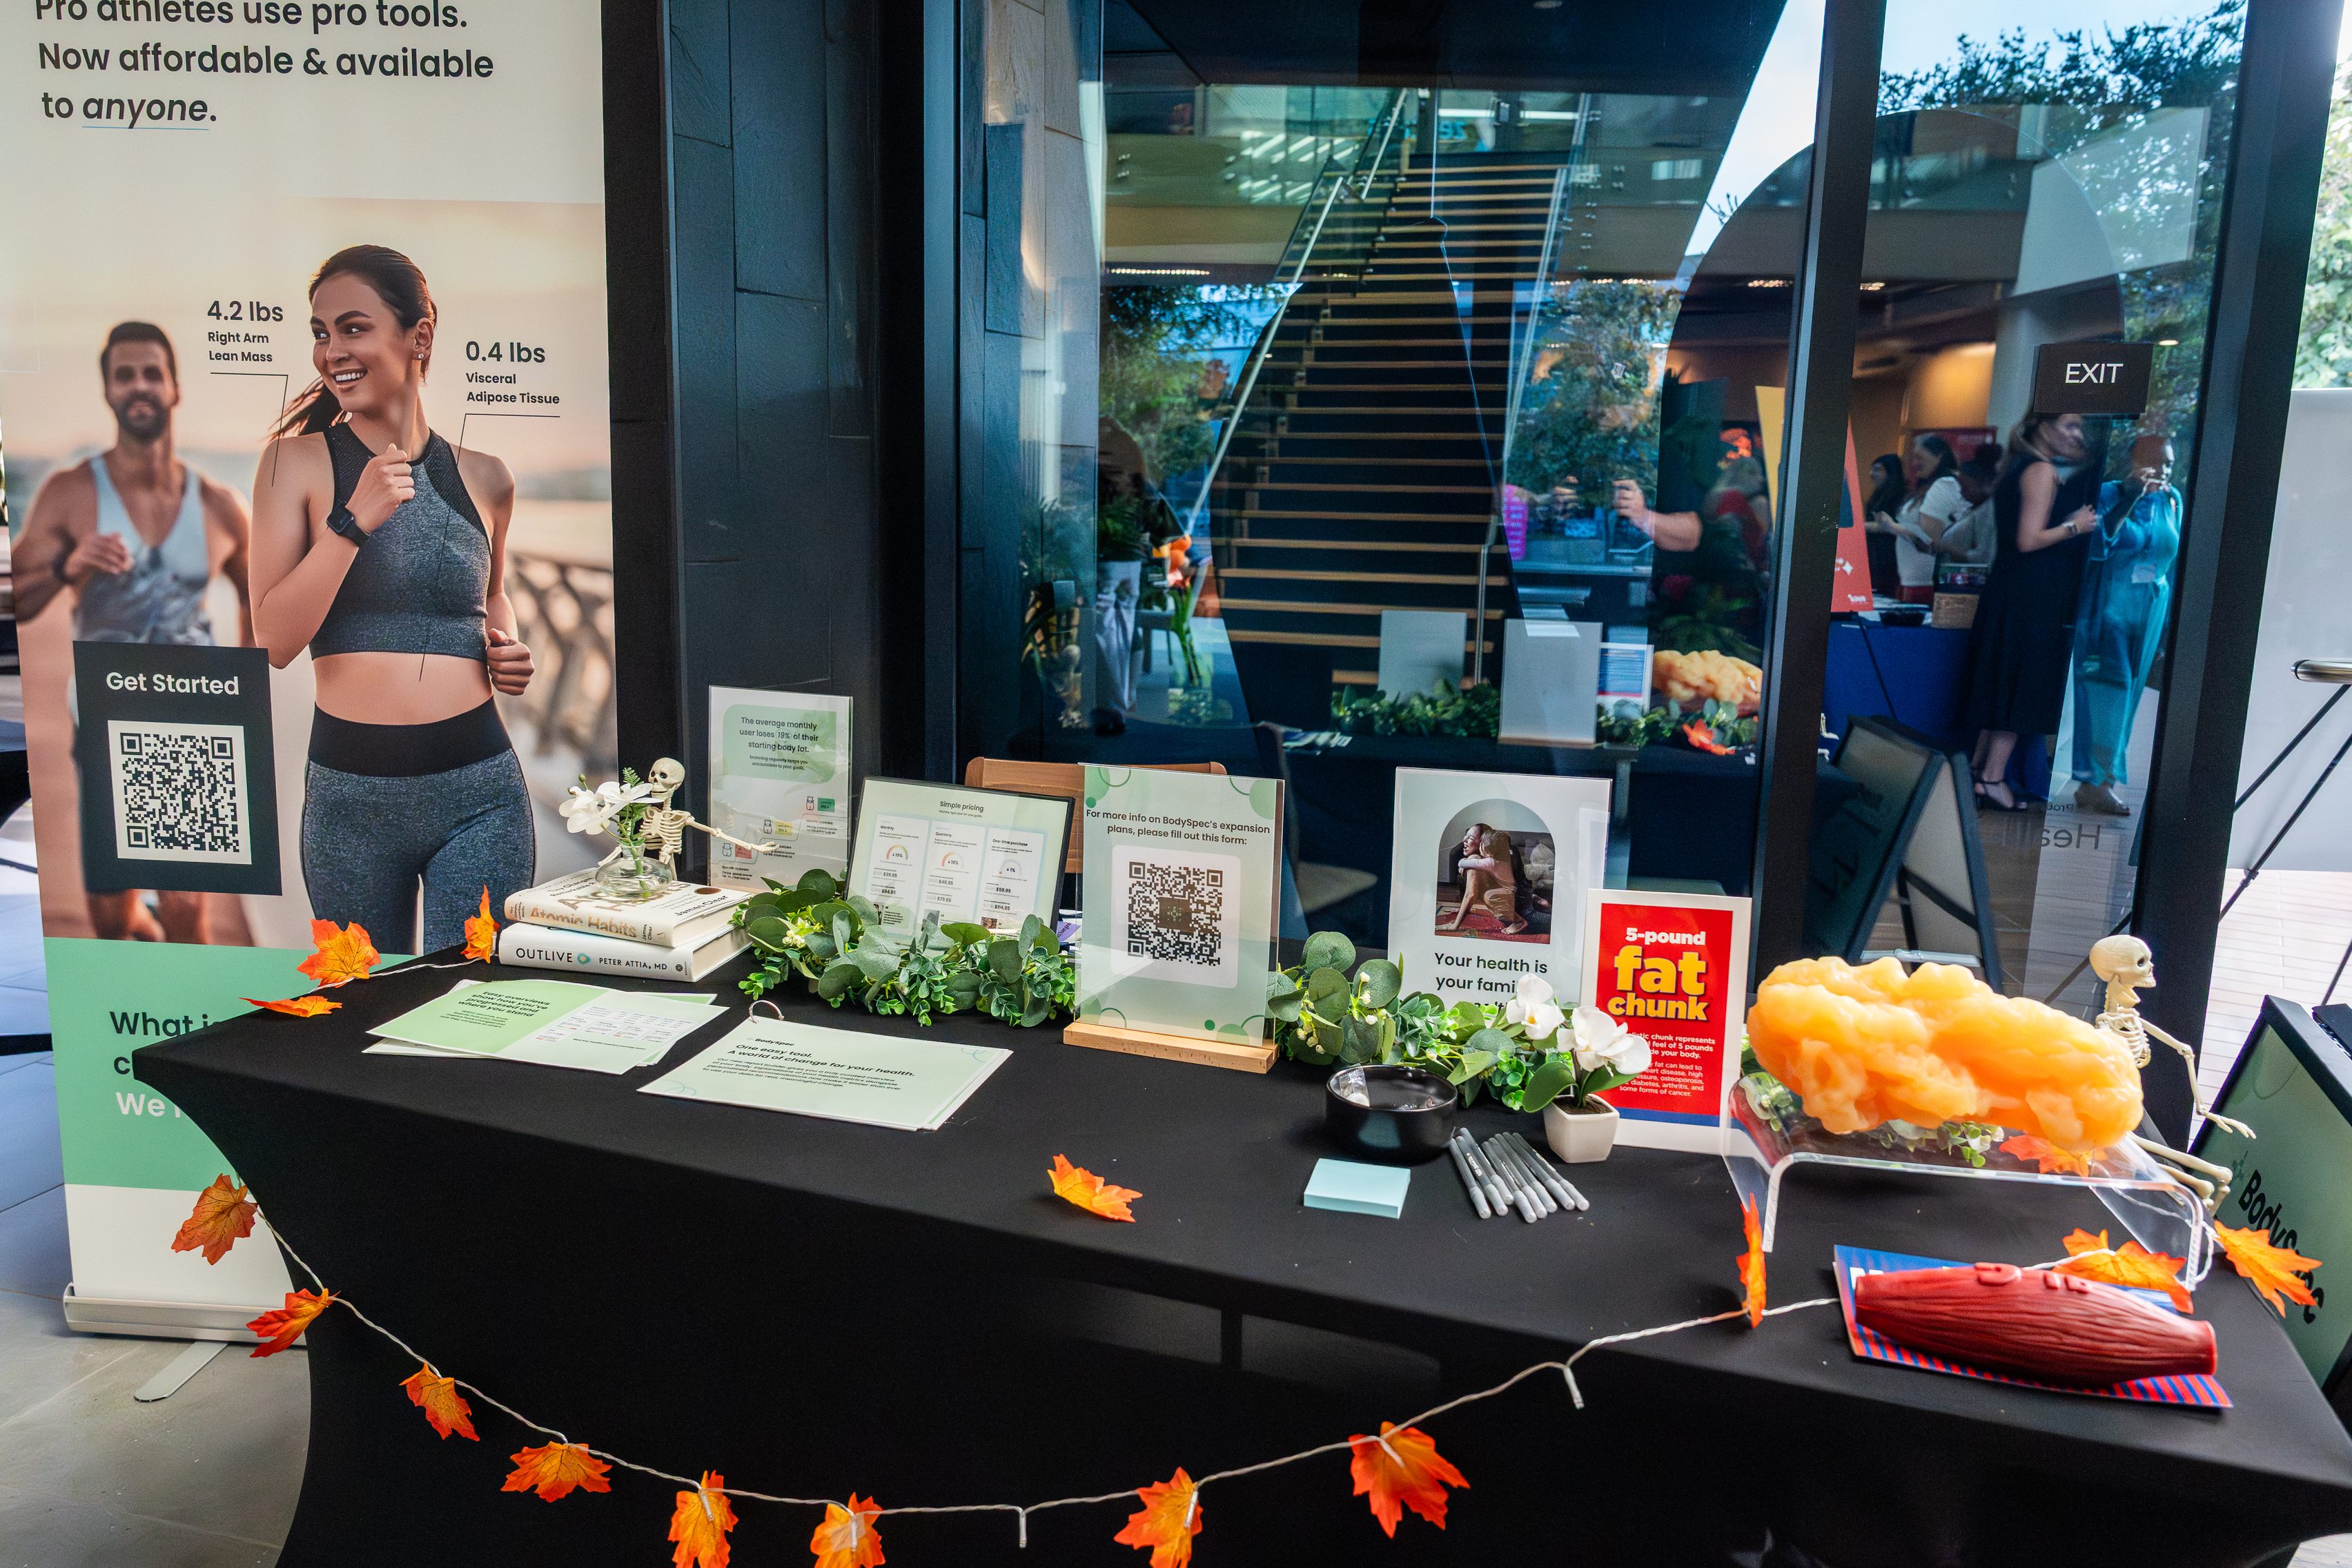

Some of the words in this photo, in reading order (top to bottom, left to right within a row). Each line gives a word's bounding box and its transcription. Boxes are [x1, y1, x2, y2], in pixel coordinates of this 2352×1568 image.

[37, 0, 88, 21] Pro
[97, 0, 233, 23] athletes
[244, 1, 302, 26] use
[313, 4, 367, 34] pro
[377, 0, 468, 28] tools.
[39, 43, 110, 71] Now
[119, 43, 293, 75] affordable
[303, 48, 329, 76] &
[336, 47, 494, 78] available
[41, 92, 74, 119] to
[83, 94, 217, 129] anyone.
[207, 300, 243, 322] 4.2
[248, 301, 284, 323] lbs
[208, 331, 239, 346] Right
[241, 332, 269, 344] Arm
[208, 350, 238, 362] Lean
[241, 351, 273, 364] Mass
[465, 341, 503, 363] 0.4
[509, 342, 546, 364] lbs
[466, 372, 516, 385] Visceral
[2065, 362, 2124, 384] EXIT
[467, 391, 516, 405] Adipose
[519, 392, 560, 404] Tissue
[106, 672, 147, 692] Get
[153, 674, 239, 695] Started
[741, 716, 754, 725] The
[756, 719, 785, 728] average
[787, 721, 817, 730] monthly
[748, 741, 776, 751] starting
[777, 743, 796, 754] body
[797, 745, 810, 753] fat.
[939, 801, 961, 811] Simple
[962, 803, 984, 813] pricing
[1086, 810, 1101, 819] For
[1102, 811, 1127, 821] more
[1129, 813, 1146, 823] info
[1219, 821, 1270, 834] expansion
[1107, 825, 1135, 836] plans,
[1137, 827, 1168, 839] please
[1170, 829, 1182, 839] fill
[1184, 832, 1199, 841] out
[1202, 832, 1219, 843] this
[1221, 834, 1247, 845] form:
[674, 905, 705, 916] James
[703, 896, 728, 905] Clear
[530, 906, 584, 928] Atomic
[588, 917, 637, 939] Habits
[1625, 927, 1706, 945] 5-pound
[516, 948, 573, 963] OUTLIVE
[599, 957, 622, 966] PETER
[625, 959, 651, 970] ATTIA,
[1434, 952, 1472, 967] Your
[1477, 956, 1529, 972] health
[1535, 960, 1547, 973] is
[1614, 945, 1707, 995] fat
[1435, 977, 1473, 990] your
[1478, 978, 1518, 993] fami
[465, 998, 518, 1010] progressed
[504, 995, 551, 1006] overviews
[1607, 992, 1709, 1021] chunk
[110, 1011, 195, 1037] What
[755, 1038, 794, 1046] BodySpec
[1680, 1050, 1701, 1059] body.
[785, 1057, 827, 1066] change
[876, 1068, 914, 1077] health.
[115, 1092, 166, 1118] We
